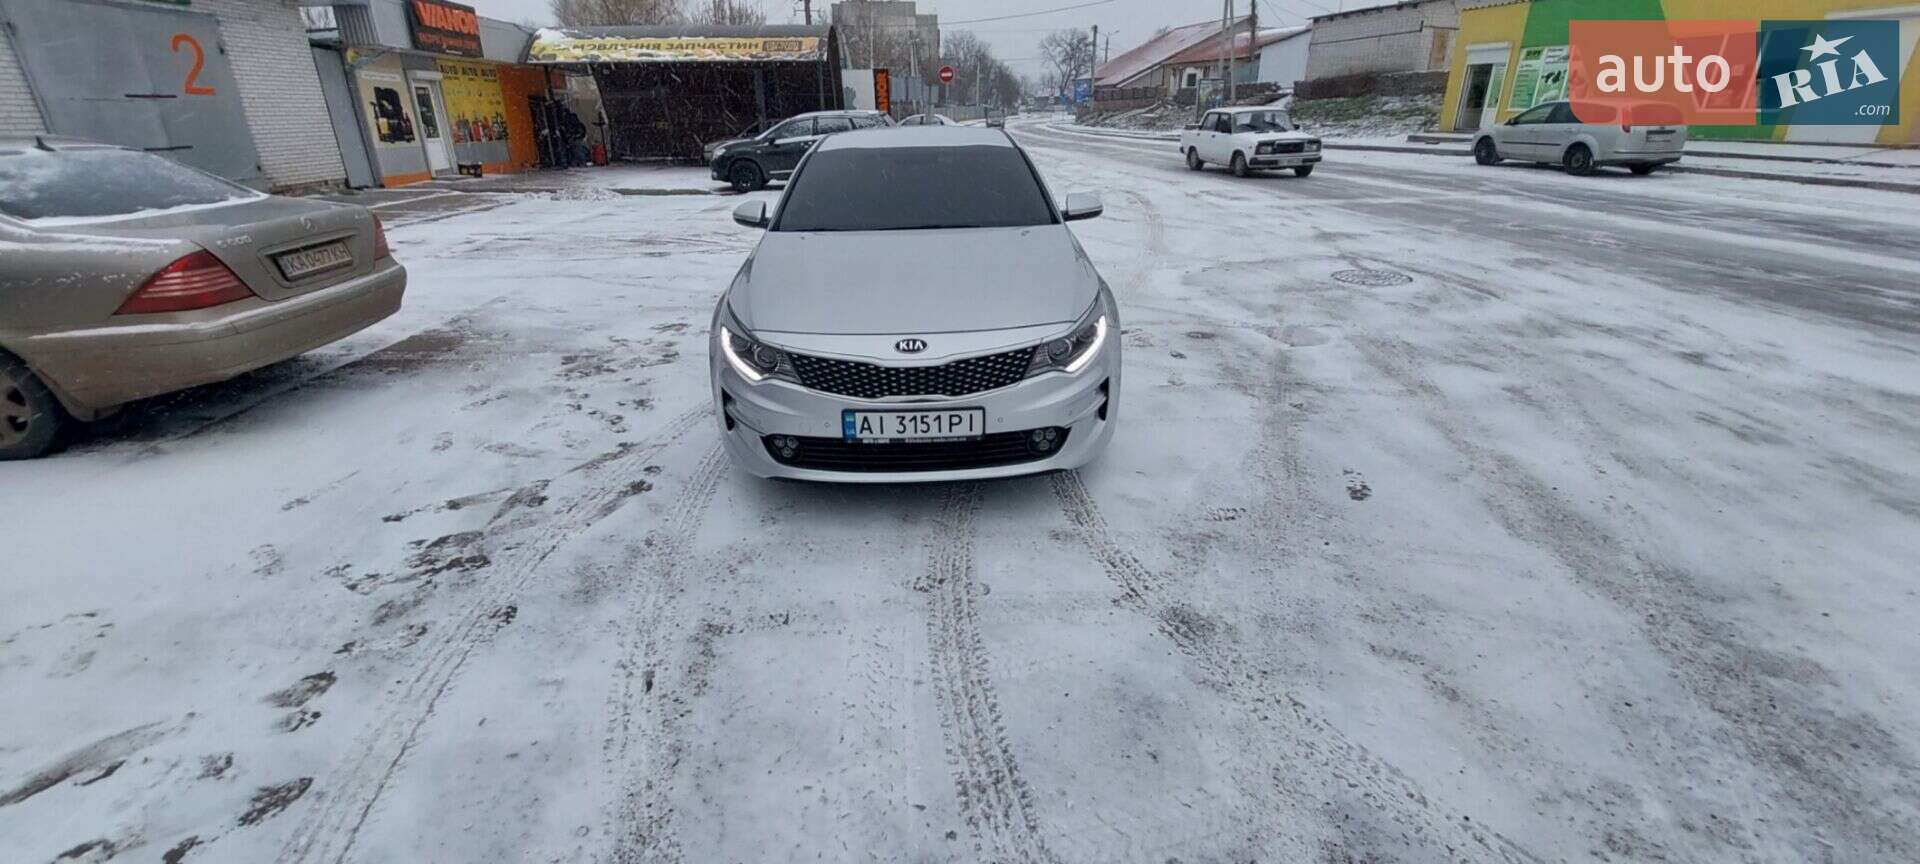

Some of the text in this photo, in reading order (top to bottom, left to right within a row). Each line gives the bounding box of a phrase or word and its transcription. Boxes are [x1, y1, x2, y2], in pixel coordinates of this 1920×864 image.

[171, 34, 215, 95] 2
[876, 71, 890, 112] ANOR
[899, 340, 924, 351] KIA
[859, 415, 884, 435] AI
